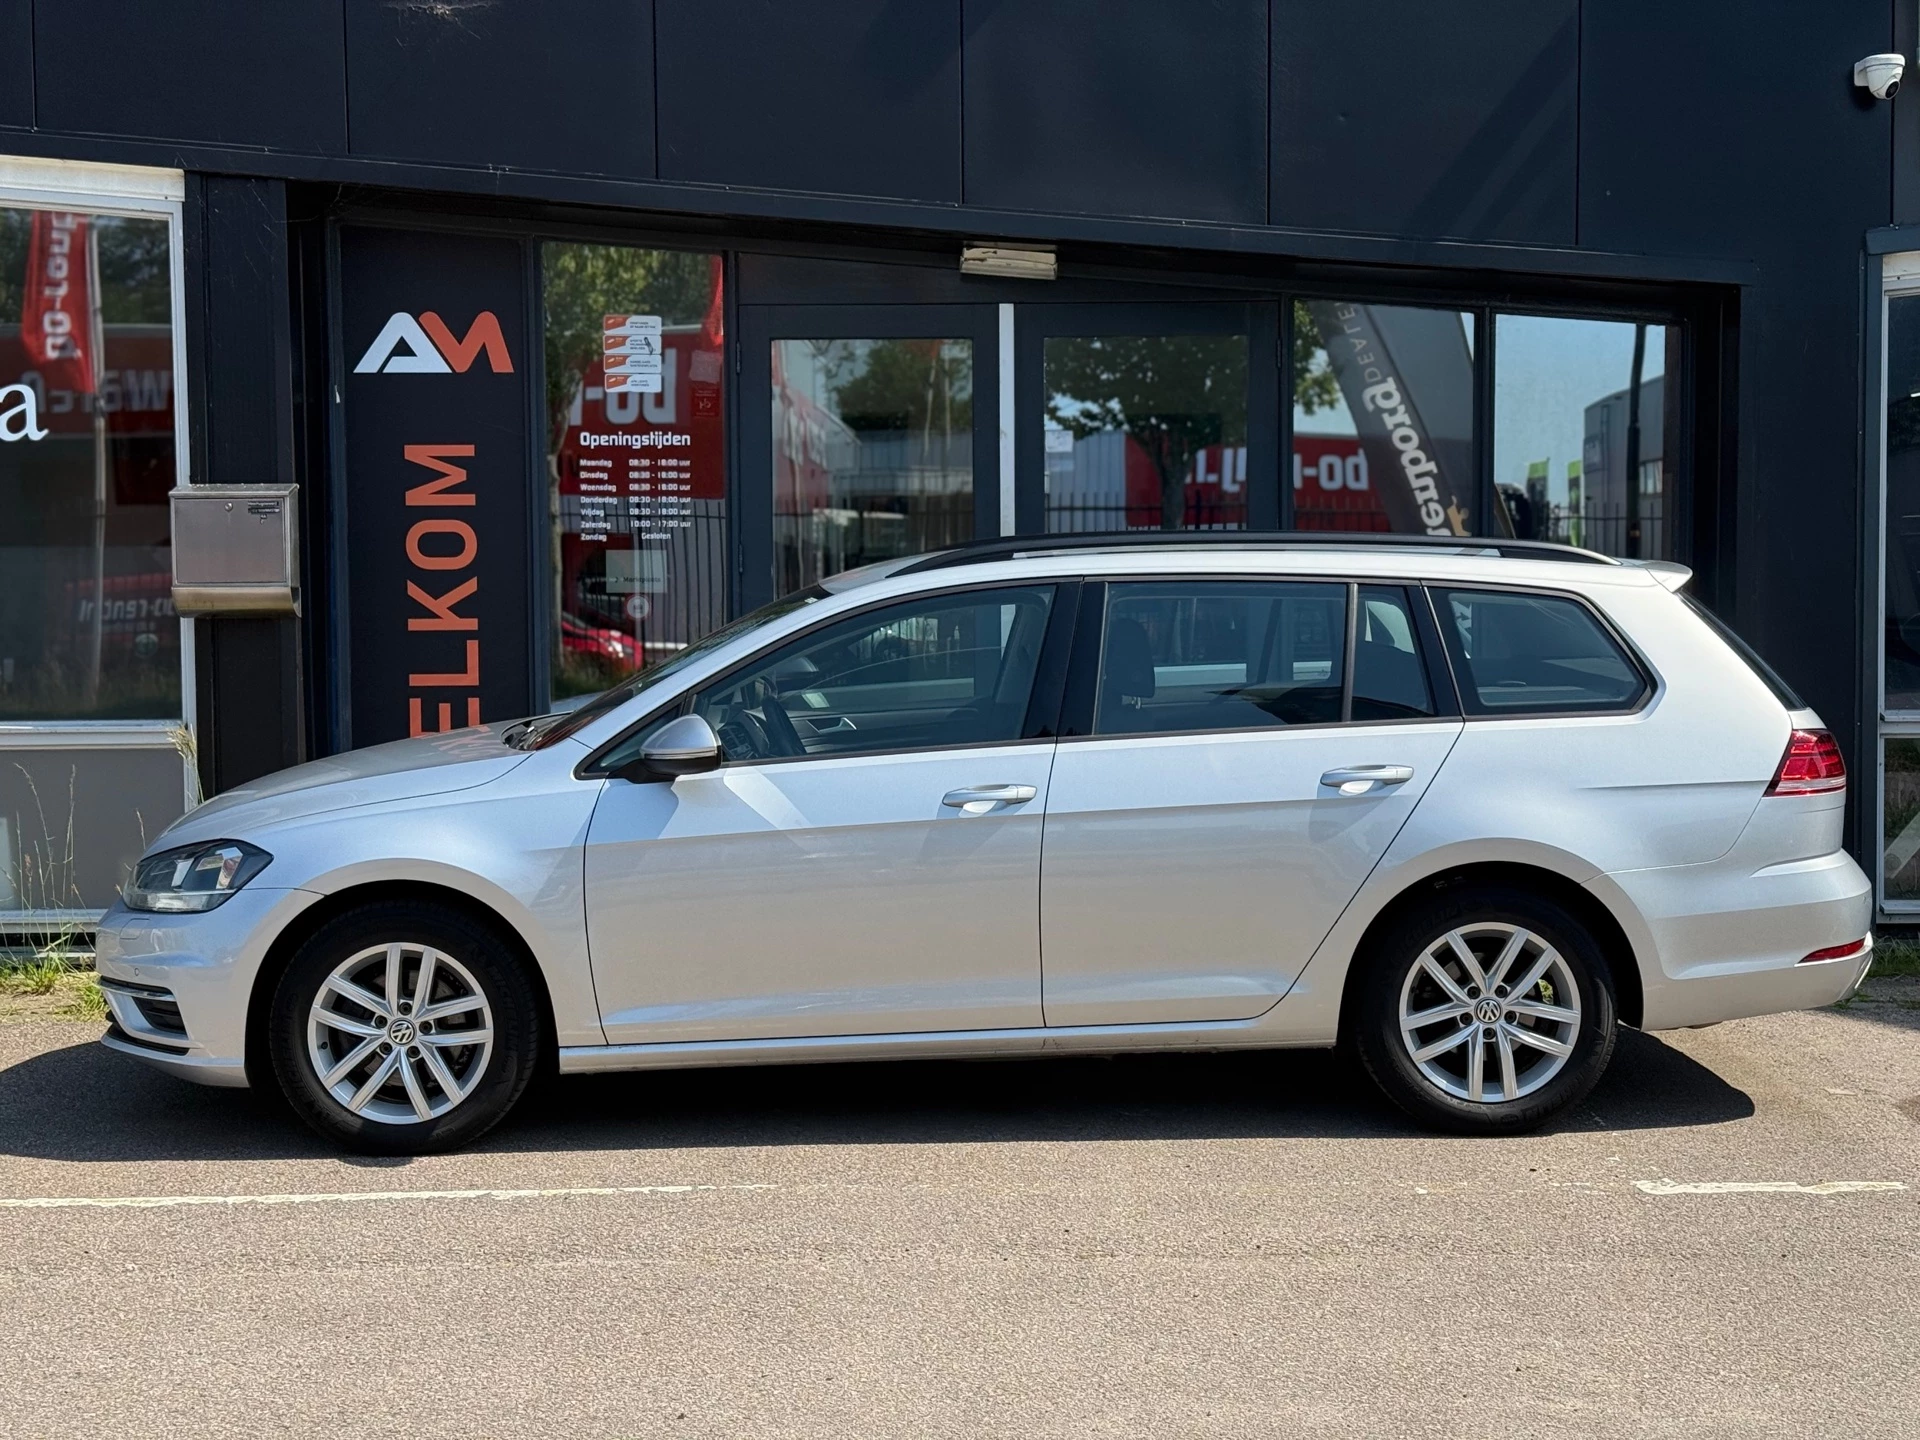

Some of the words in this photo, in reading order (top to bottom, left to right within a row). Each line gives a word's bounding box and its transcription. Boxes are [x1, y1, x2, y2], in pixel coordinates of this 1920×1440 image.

[580, 431, 691, 449] Openingstijden
[580, 459, 612, 468] Maandag
[629, 459, 651, 467] 08:30
[580, 471, 608, 480] Dinsdag
[629, 471, 651, 479] 08:30
[580, 483, 617, 492] Woensdag
[629, 483, 651, 491] 08:30
[580, 496, 618, 504] Donderdag
[580, 508, 604, 517] Vrijdag
[580, 521, 611, 530] Zaterdag
[630, 520, 651, 528] 10:00
[580, 533, 607, 542] Zondag
[641, 532, 671, 540] Gesloten
